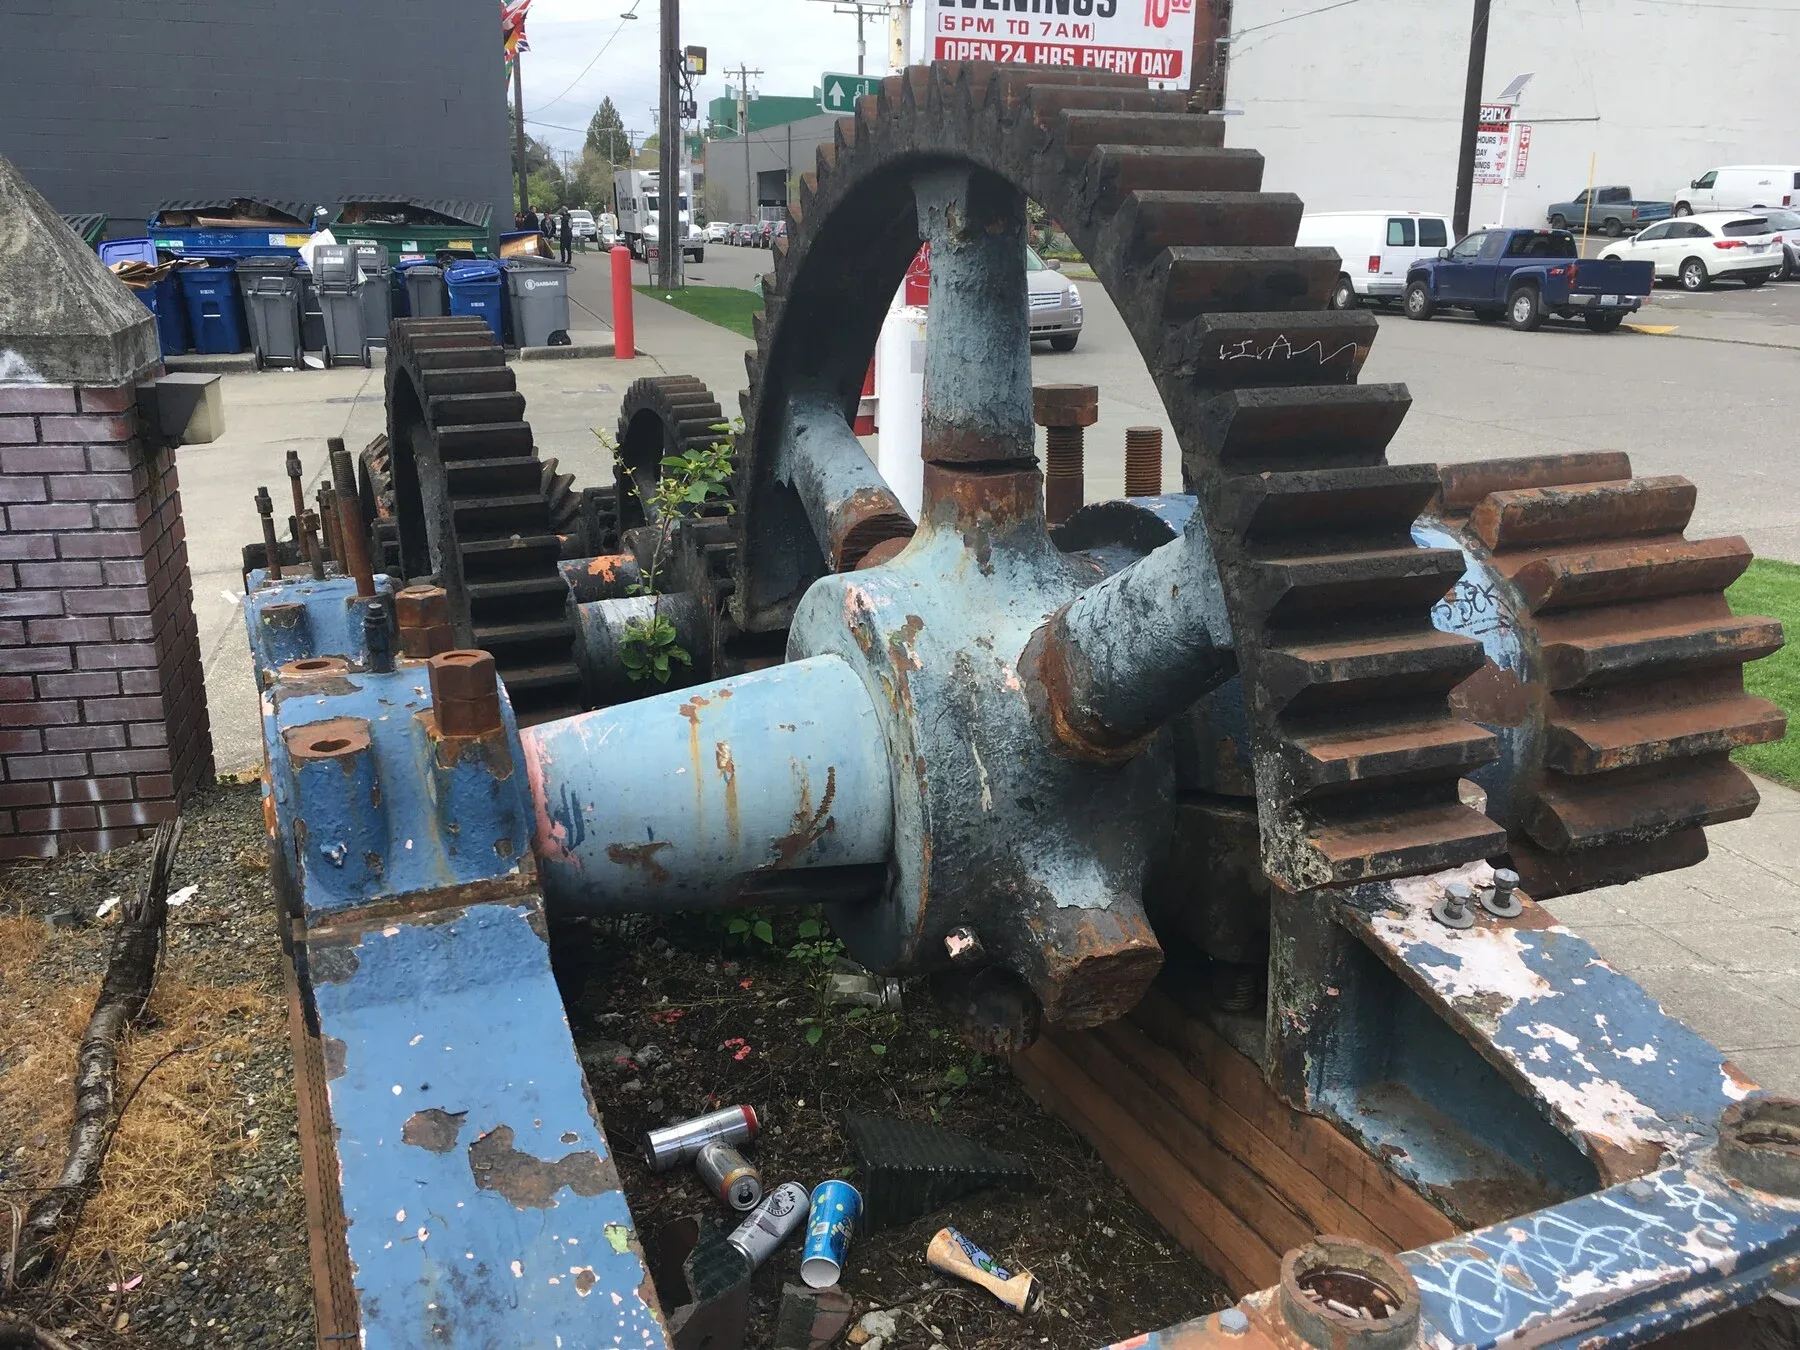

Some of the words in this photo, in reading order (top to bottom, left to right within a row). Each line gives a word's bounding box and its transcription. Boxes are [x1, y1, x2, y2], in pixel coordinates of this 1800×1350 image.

[1006, 19, 1030, 35] TO
[944, 40, 996, 62] OPEN
[1000, 44, 1027, 64] 24
[1034, 46, 1075, 66] HRS
[1083, 49, 1137, 74] EVERY
[1140, 52, 1173, 75] DAY
[1477, 136, 1497, 144] HOURS
[1521, 126, 1531, 145] PAY
